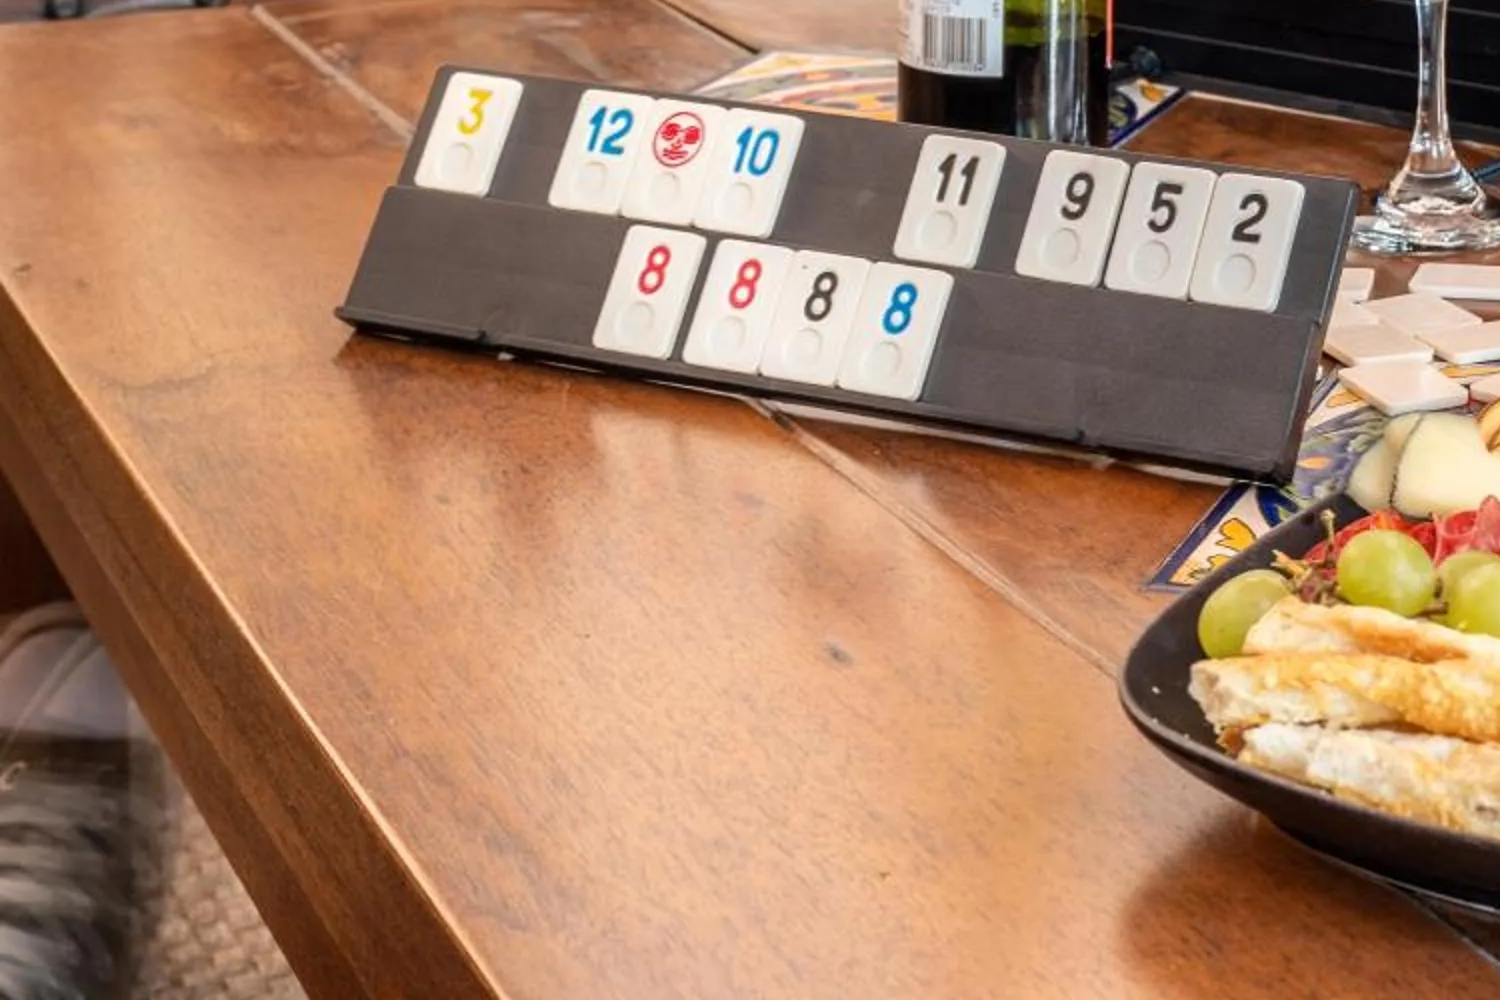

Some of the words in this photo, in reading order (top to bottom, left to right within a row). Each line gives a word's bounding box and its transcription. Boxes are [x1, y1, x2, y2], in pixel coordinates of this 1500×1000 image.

[457, 88, 492, 135] 3
[587, 106, 634, 155] 12
[734, 126, 780, 177] 10
[937, 153, 980, 207] 11
[1060, 171, 1096, 220] 9
[1147, 182, 1184, 233] 5
[1232, 193, 1268, 244] 2
[638, 245, 671, 295] 8
[729, 258, 762, 309] 8
[803, 271, 838, 321] 8
[882, 282, 918, 334] 8
